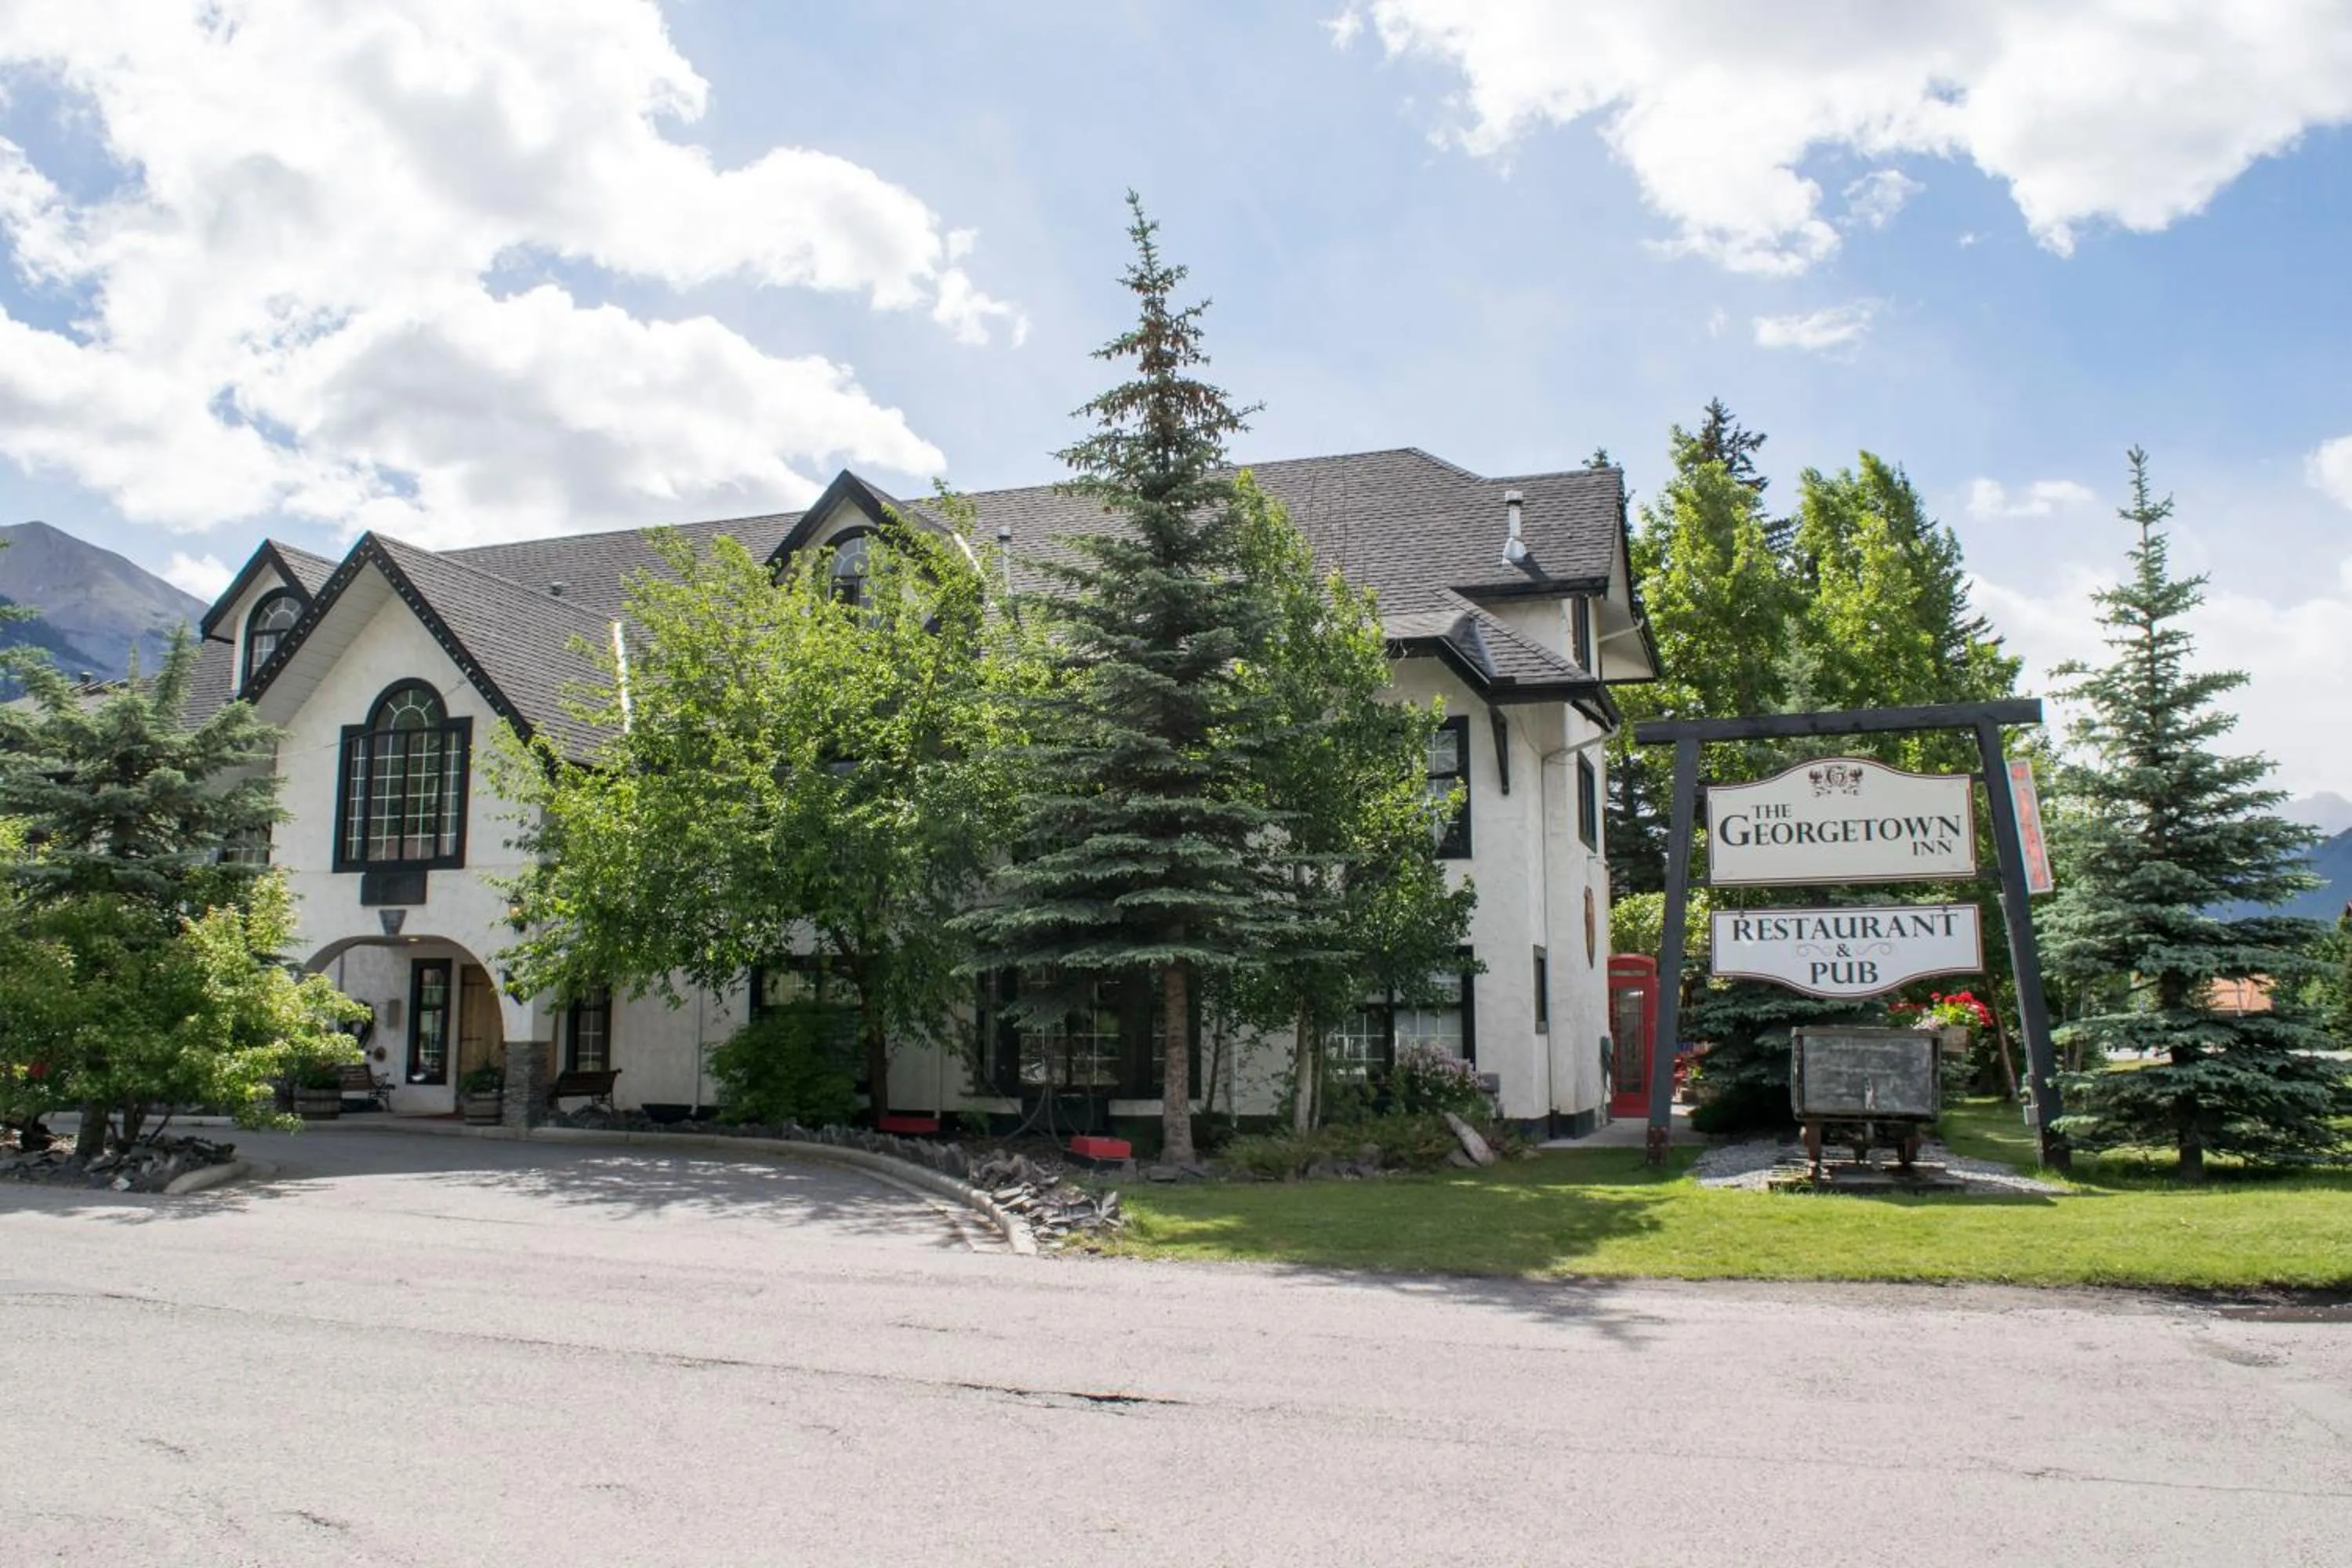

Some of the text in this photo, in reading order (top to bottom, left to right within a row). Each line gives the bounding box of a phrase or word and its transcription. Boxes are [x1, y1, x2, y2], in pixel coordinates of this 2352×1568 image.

[1751, 804, 1792, 818] THE
[1719, 815, 1961, 847] GEORGETOWN
[1911, 840, 1952, 856] INN
[1733, 913, 1958, 941] RESTAURANT
[1835, 943, 1852, 957] &
[1810, 960, 1878, 984] PUB
